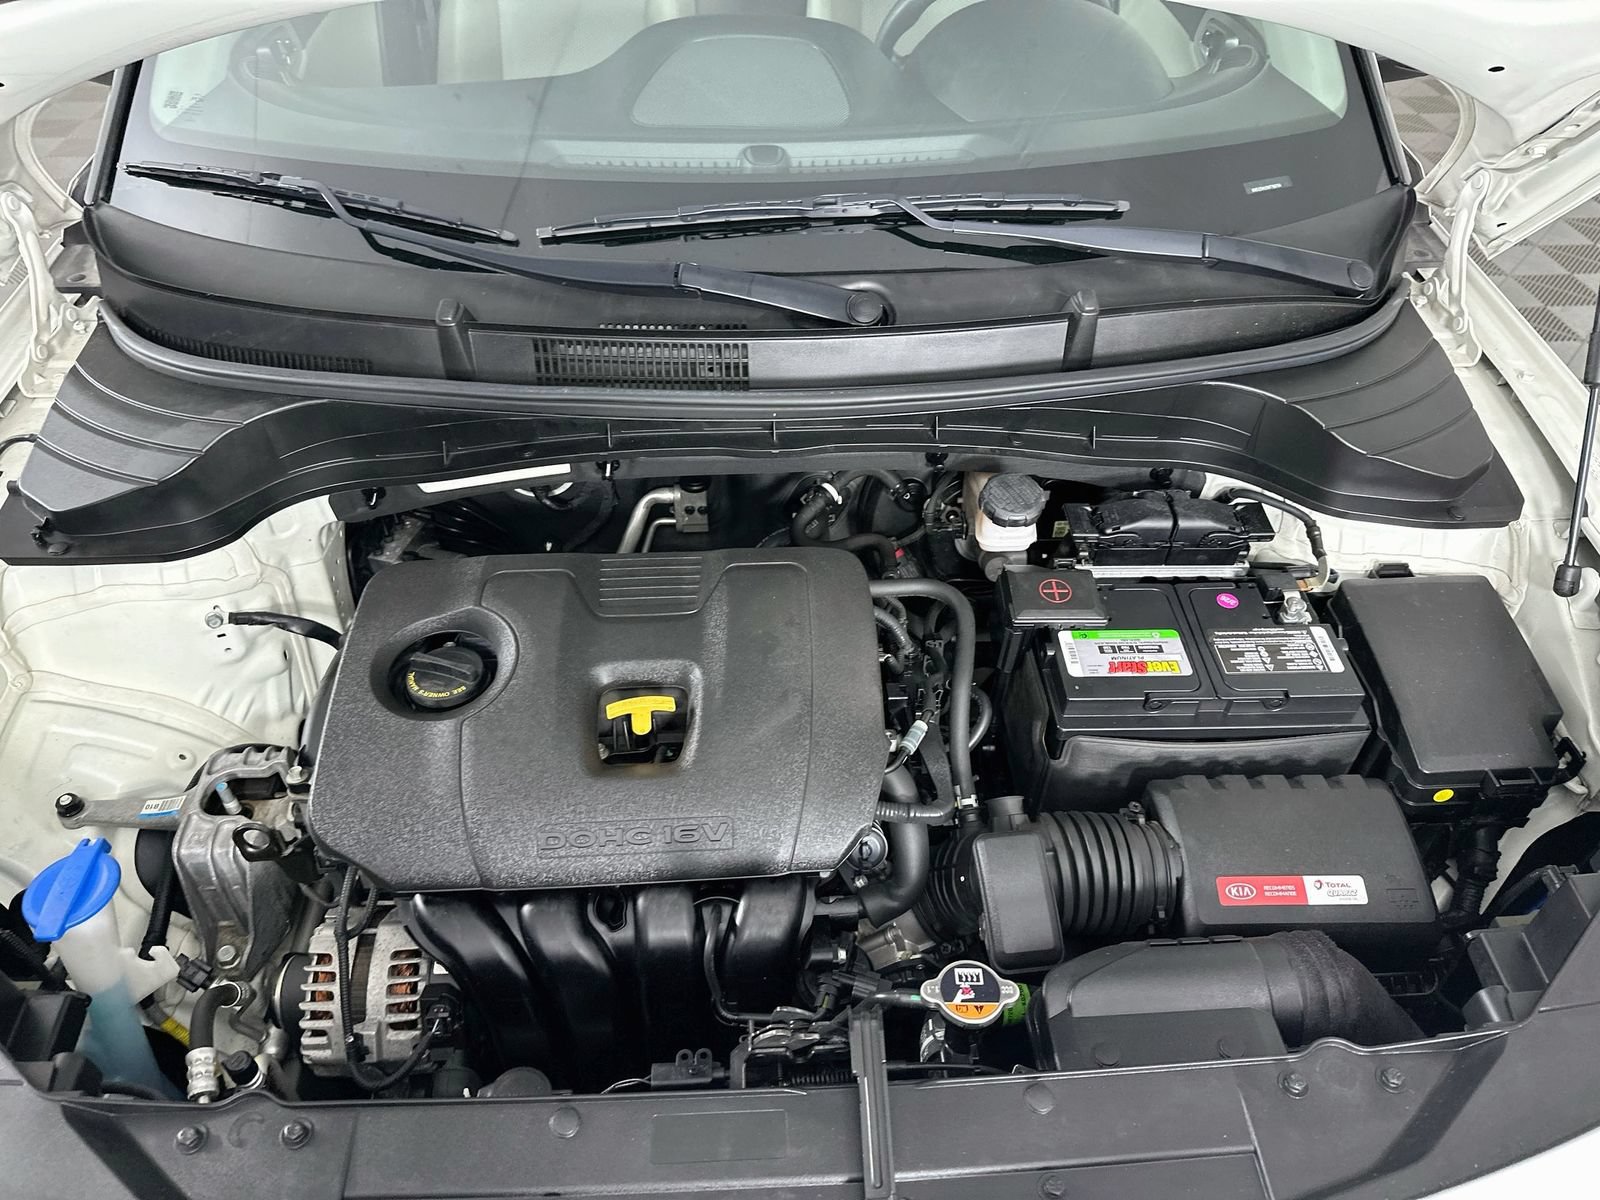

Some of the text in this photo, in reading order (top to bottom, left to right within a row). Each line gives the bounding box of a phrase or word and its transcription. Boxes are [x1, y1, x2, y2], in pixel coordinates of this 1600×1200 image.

[1108, 660, 1180, 675] EverStart
[541, 821, 730, 850] DOHC 16V
[1229, 886, 1252, 897] KIA
